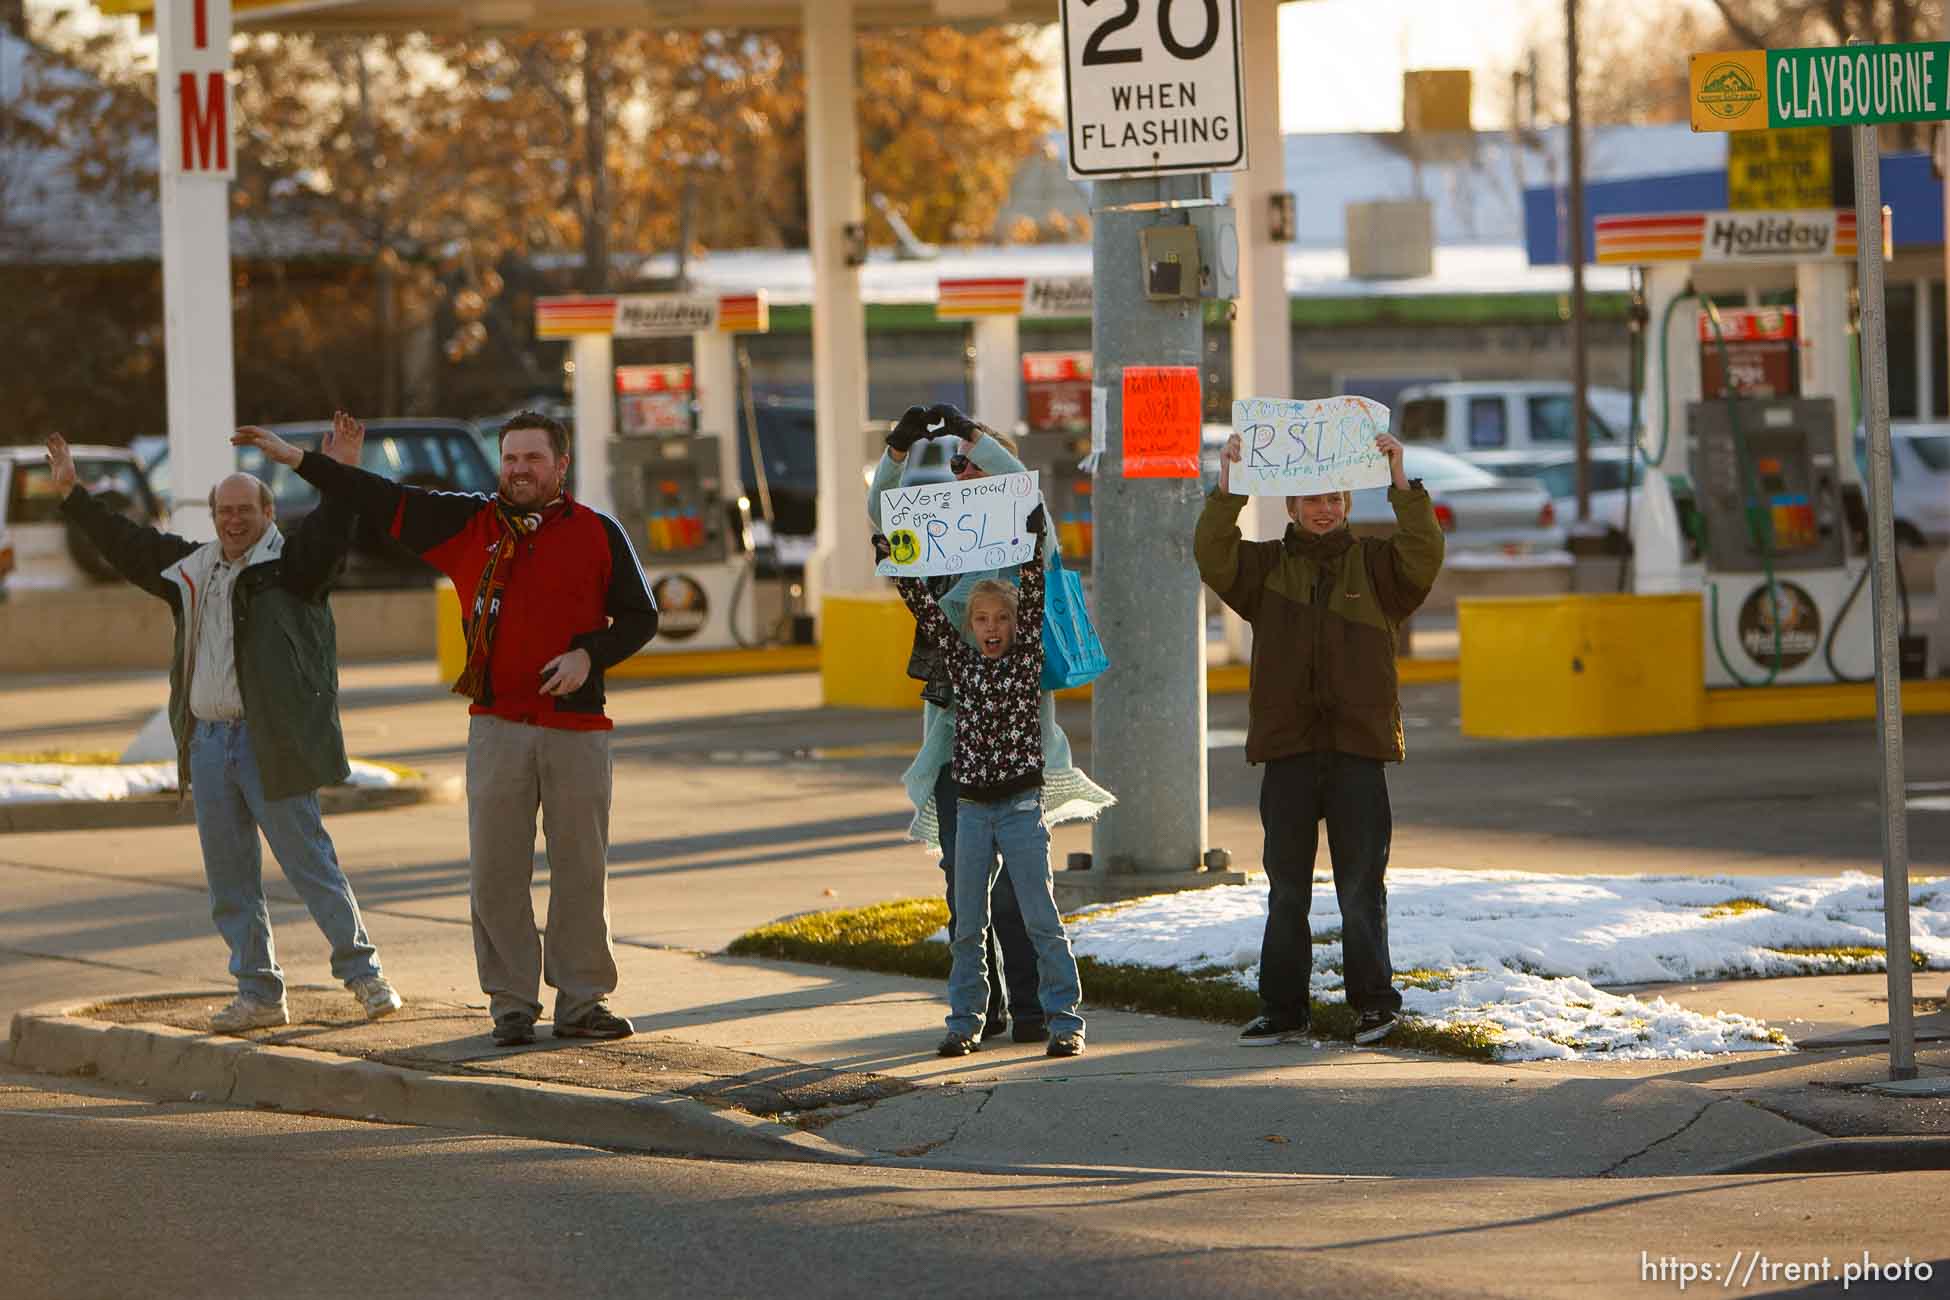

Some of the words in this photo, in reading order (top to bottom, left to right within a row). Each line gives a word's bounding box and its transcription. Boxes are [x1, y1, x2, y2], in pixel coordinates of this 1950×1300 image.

[1082, 0, 1220, 66] 20
[1111, 82, 1196, 111] WHEN
[1776, 51, 1937, 120] CLAYBOURNE
[1081, 116, 1229, 150] FLASHING
[1711, 218, 1829, 255] Holiday
[891, 506, 911, 526] of
[912, 511, 937, 527] you
